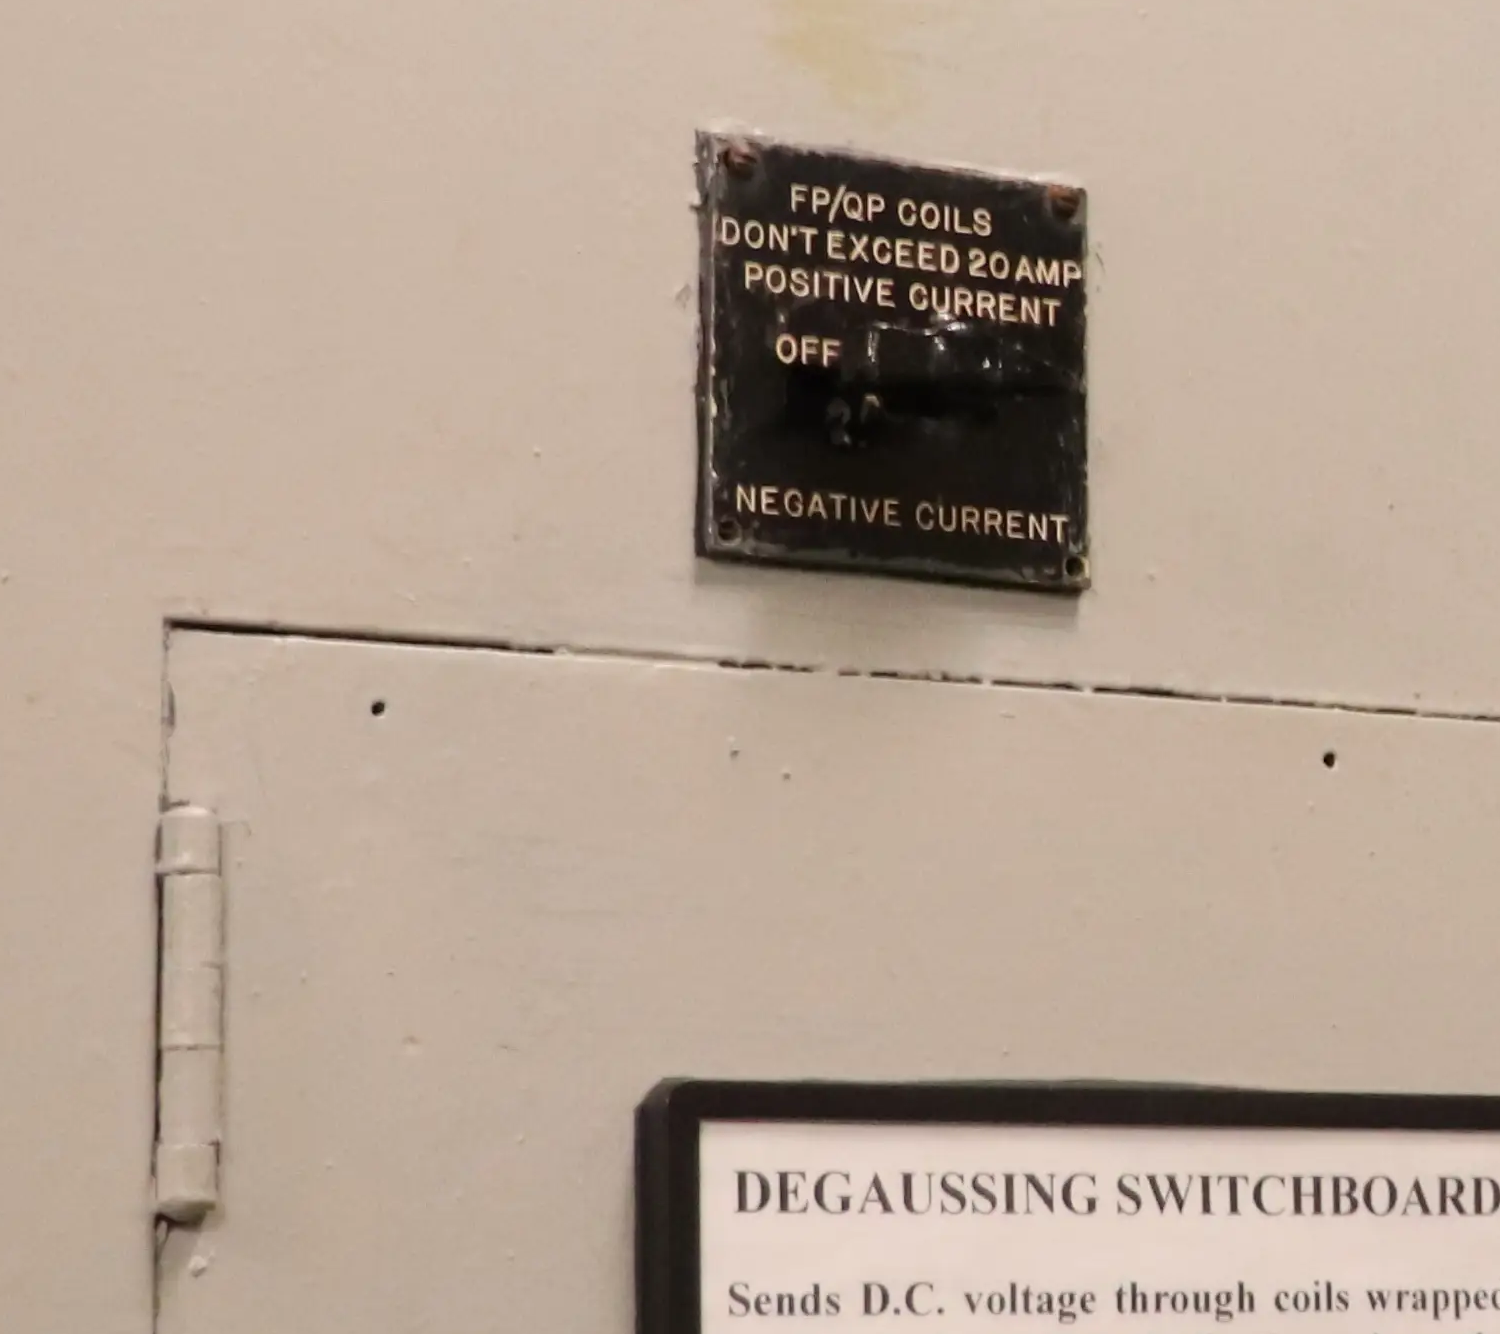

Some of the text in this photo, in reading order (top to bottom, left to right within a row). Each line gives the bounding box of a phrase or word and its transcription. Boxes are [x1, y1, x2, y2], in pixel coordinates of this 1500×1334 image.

[790, 183, 992, 238] FP/QP COILS
[719, 216, 1082, 289] DON'T EXCEED 20 AMP
[744, 262, 1062, 327] POSITIVE CURRENT
[775, 333, 842, 367] OFF
[735, 484, 1070, 543] NEGATIVE CURRENT
[734, 1170, 1099, 1216] DEGAUSSING
[728, 1281, 841, 1318] Sends
[863, 1282, 945, 1317] D.C.
[964, 1282, 1096, 1325] voltage
[1116, 1281, 1255, 1321] through
[1274, 1280, 1350, 1313] coils
